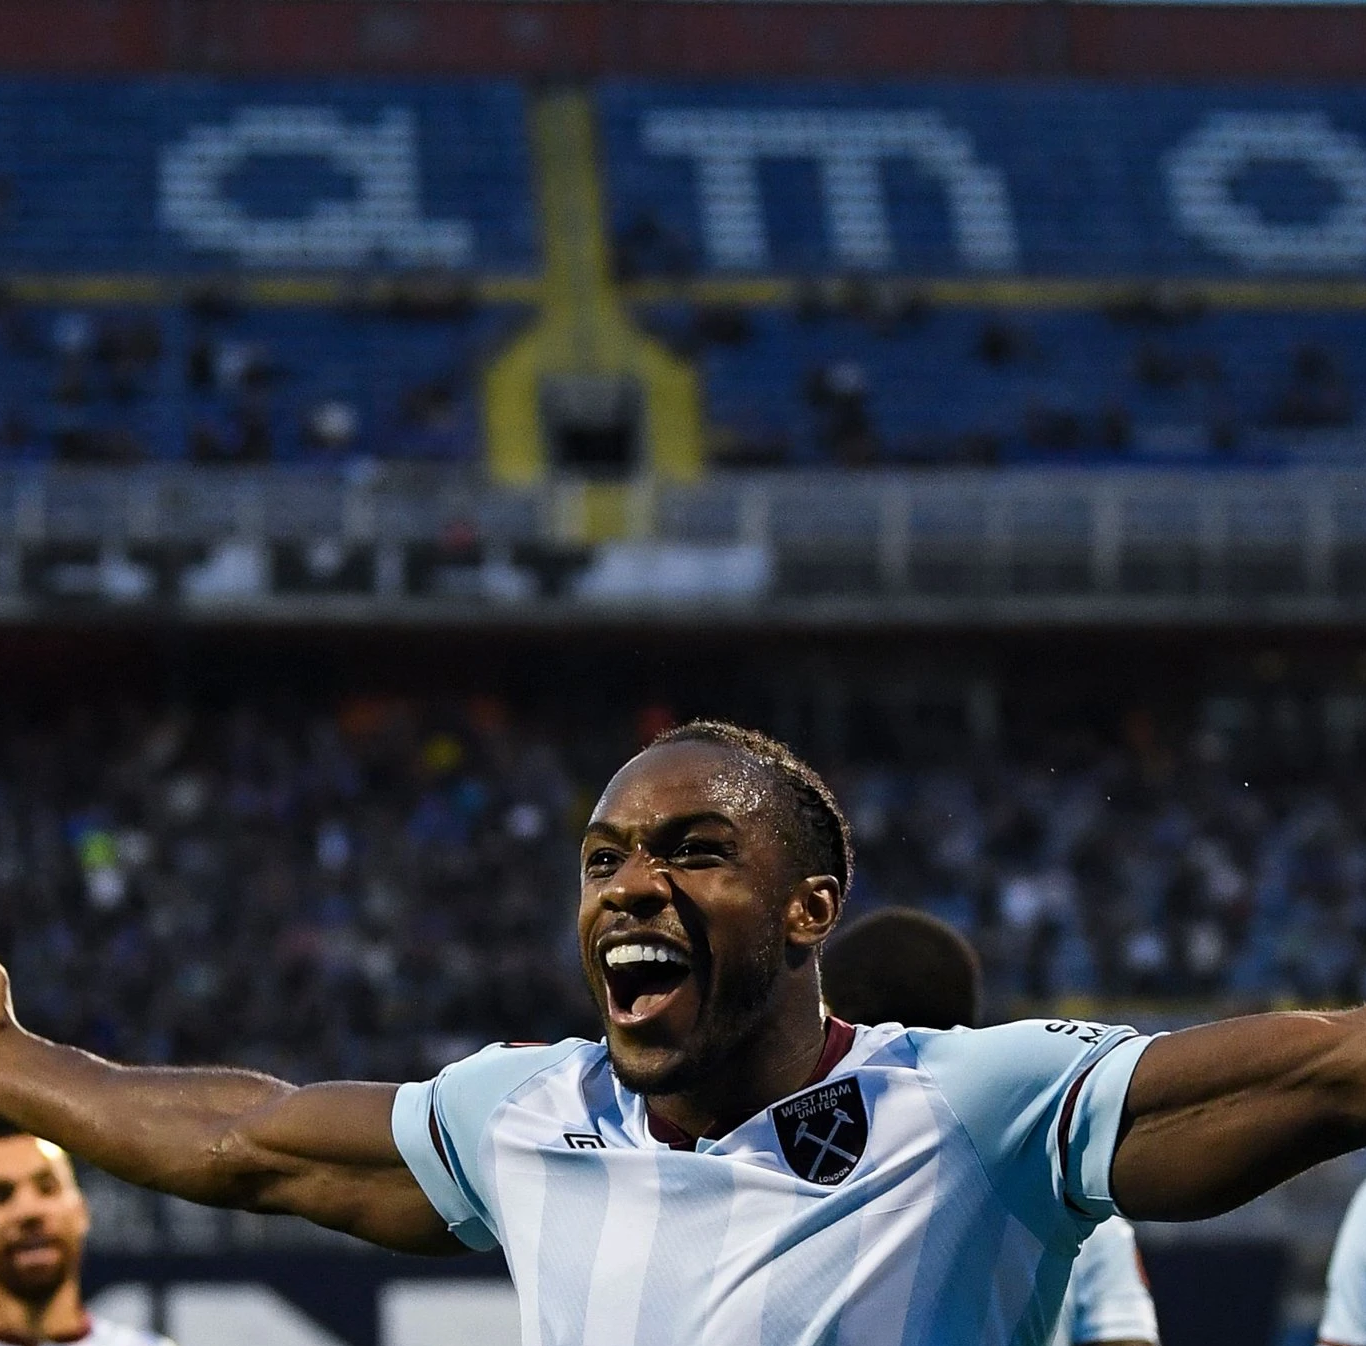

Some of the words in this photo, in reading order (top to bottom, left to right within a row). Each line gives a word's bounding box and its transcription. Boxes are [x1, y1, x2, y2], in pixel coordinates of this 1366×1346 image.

[780, 1094, 816, 1118] WEST
[819, 1084, 852, 1102] HAM
[797, 1098, 838, 1119] UNITED
[818, 1166, 850, 1183] LONDON
